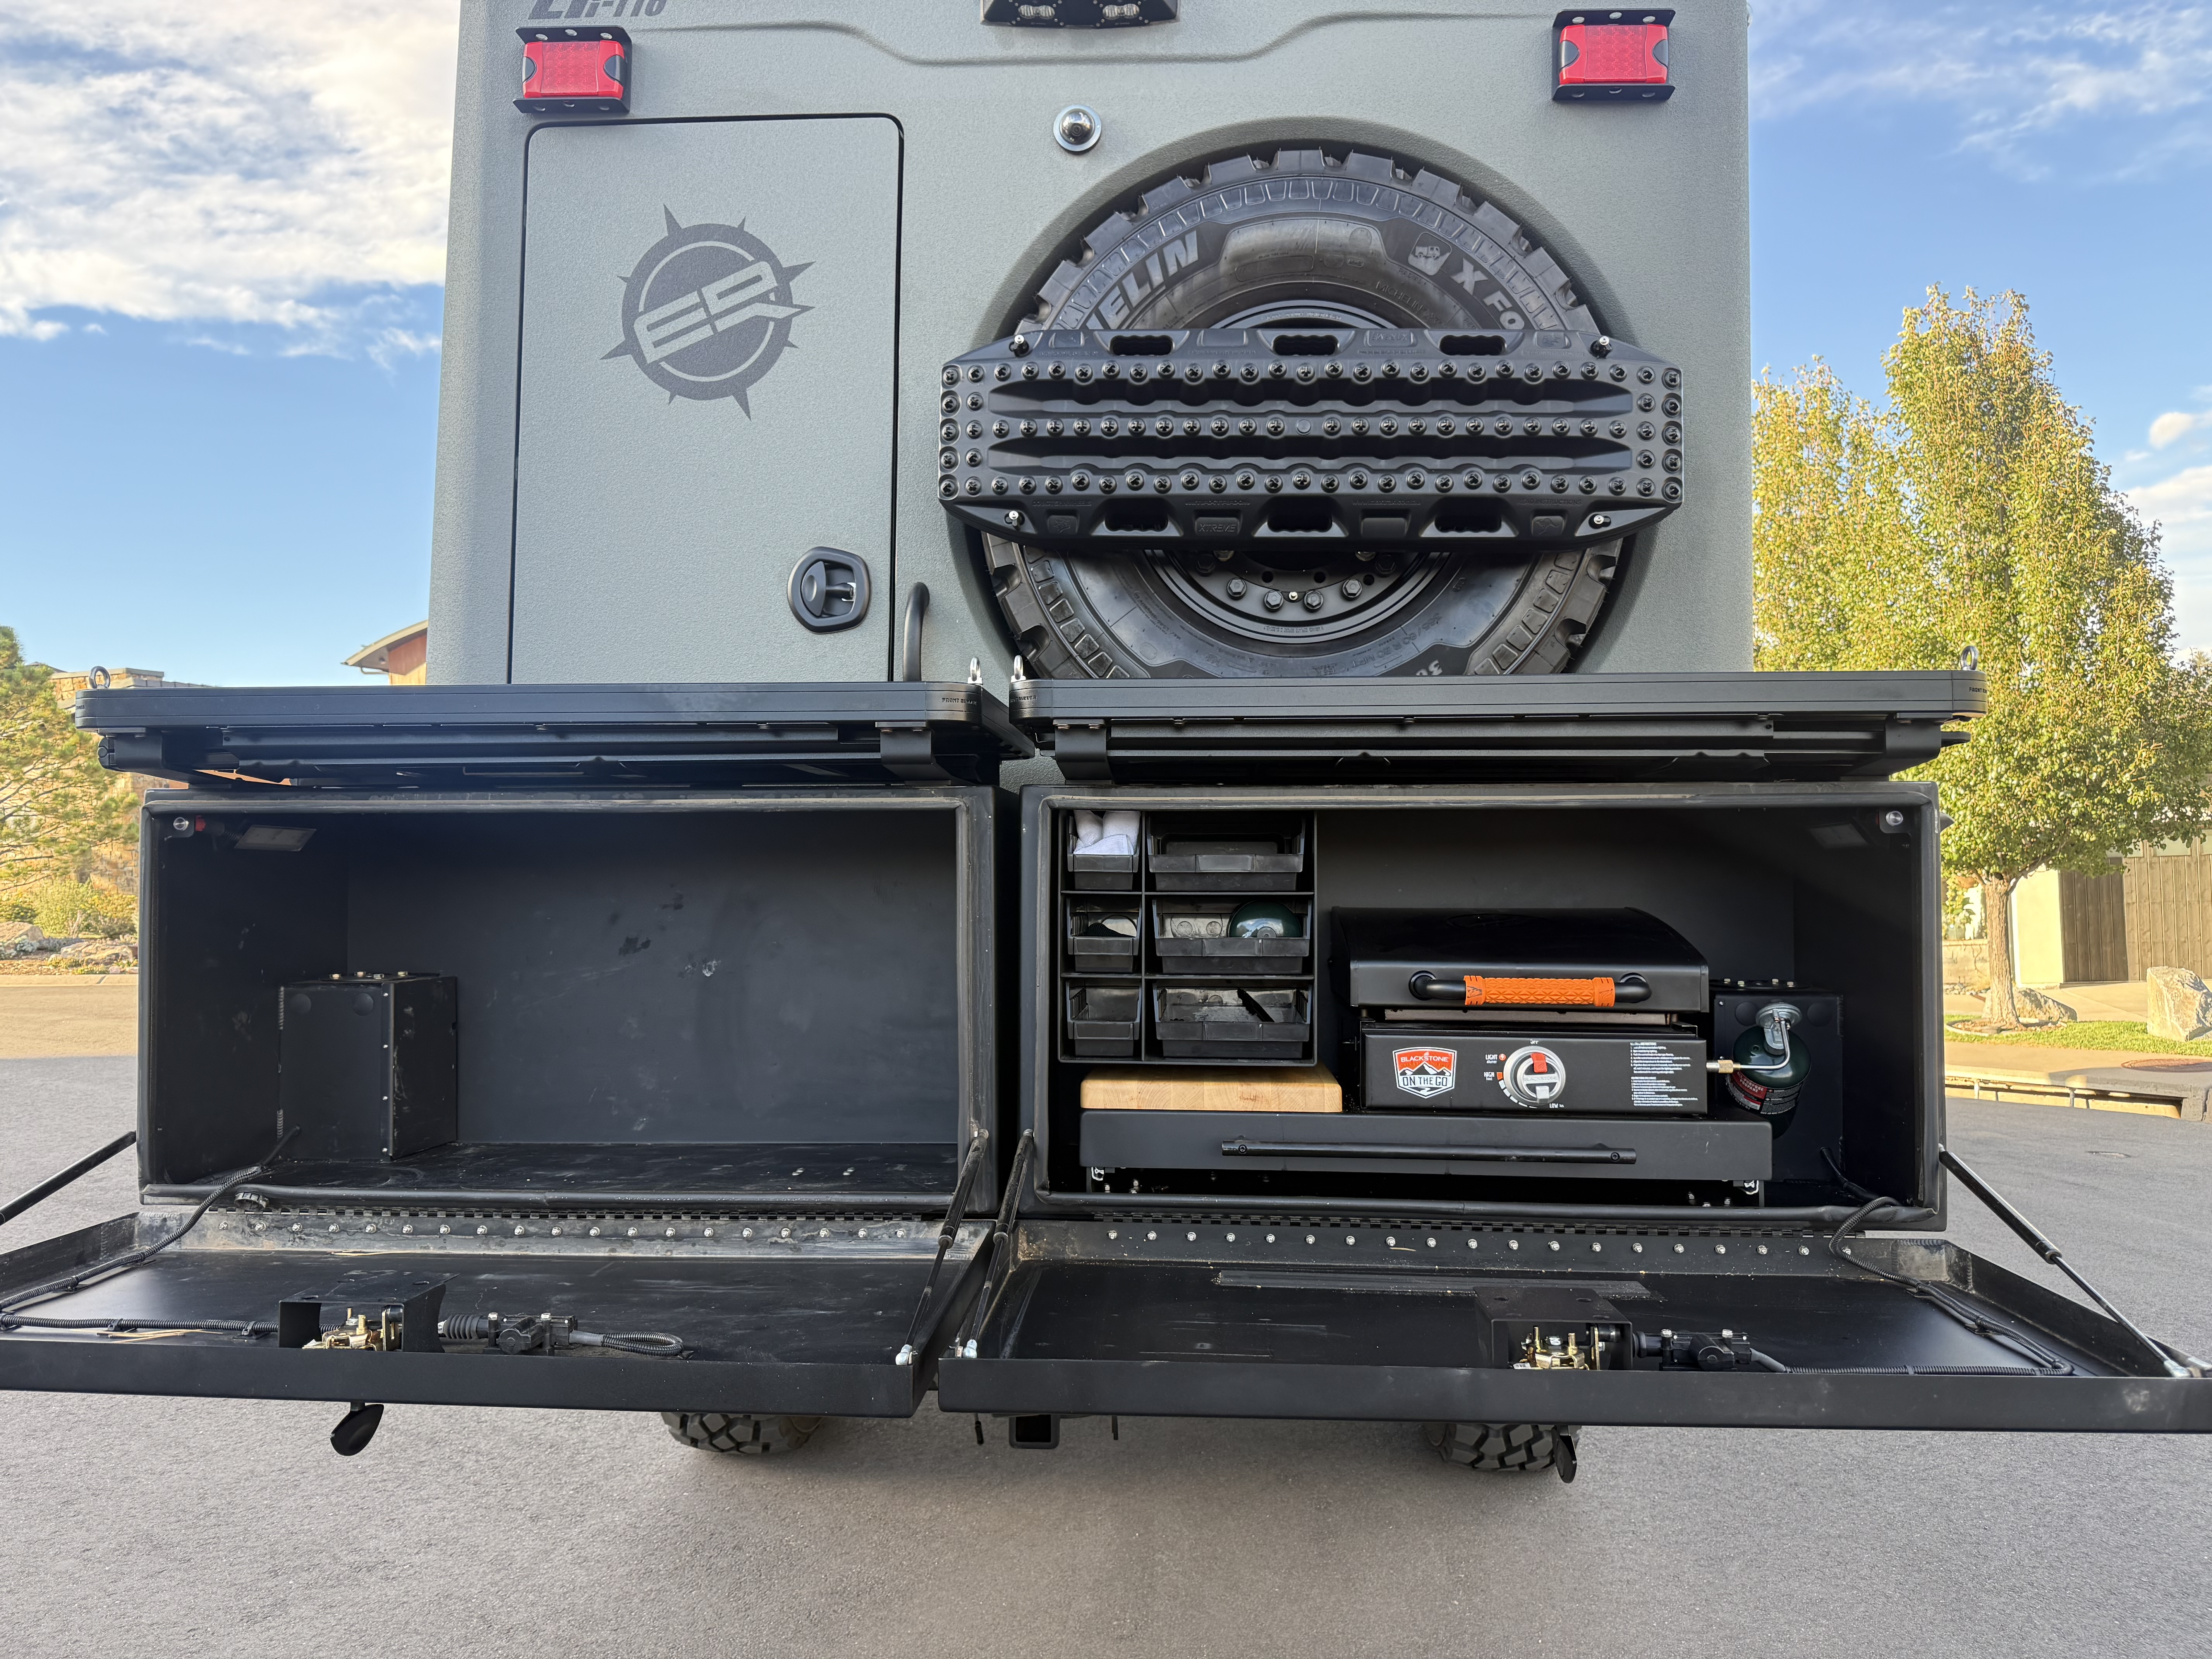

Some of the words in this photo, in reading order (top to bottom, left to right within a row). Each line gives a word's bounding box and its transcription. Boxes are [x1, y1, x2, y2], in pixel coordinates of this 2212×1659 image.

[1450, 258, 1489, 295] X
[1376, 282, 1424, 311] MICHELIN
[1403, 1076, 1415, 1086] ON
[1418, 1077, 1434, 1085] THE
[1436, 1076, 1448, 1086] GO
